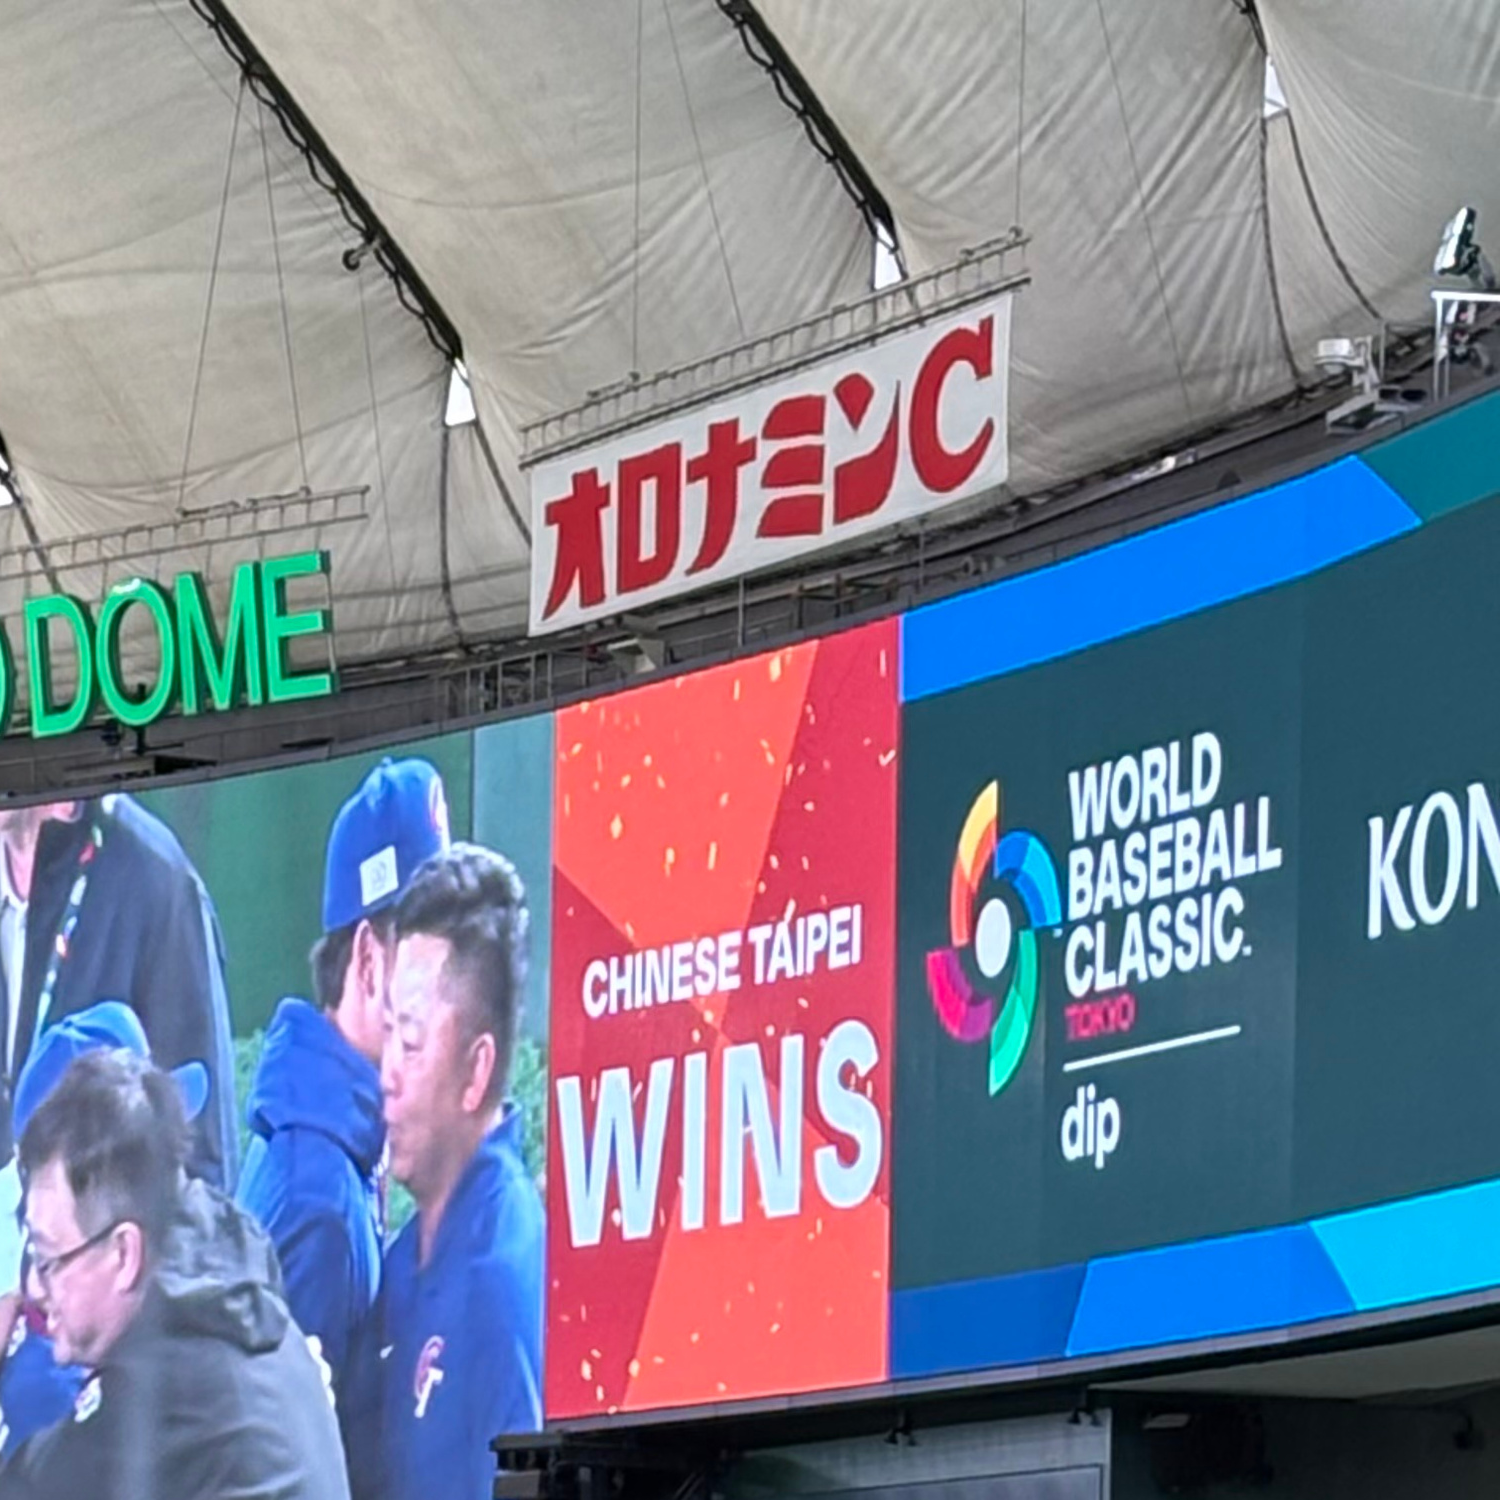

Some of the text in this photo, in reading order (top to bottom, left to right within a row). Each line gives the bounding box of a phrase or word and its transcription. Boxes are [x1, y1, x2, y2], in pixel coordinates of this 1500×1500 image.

[543, 314, 995, 621] オロナミンC
[24, 550, 338, 740] DOME
[1068, 731, 1222, 841] WORLD
[1068, 796, 1282, 921] BASEBALL
[1367, 781, 1500, 941] KON
[582, 903, 863, 1019] CHINESE TAIPEI
[1064, 993, 1136, 1042] TOKYO
[556, 1019, 883, 1249] WINS
[1061, 1082, 1121, 1170] dip
